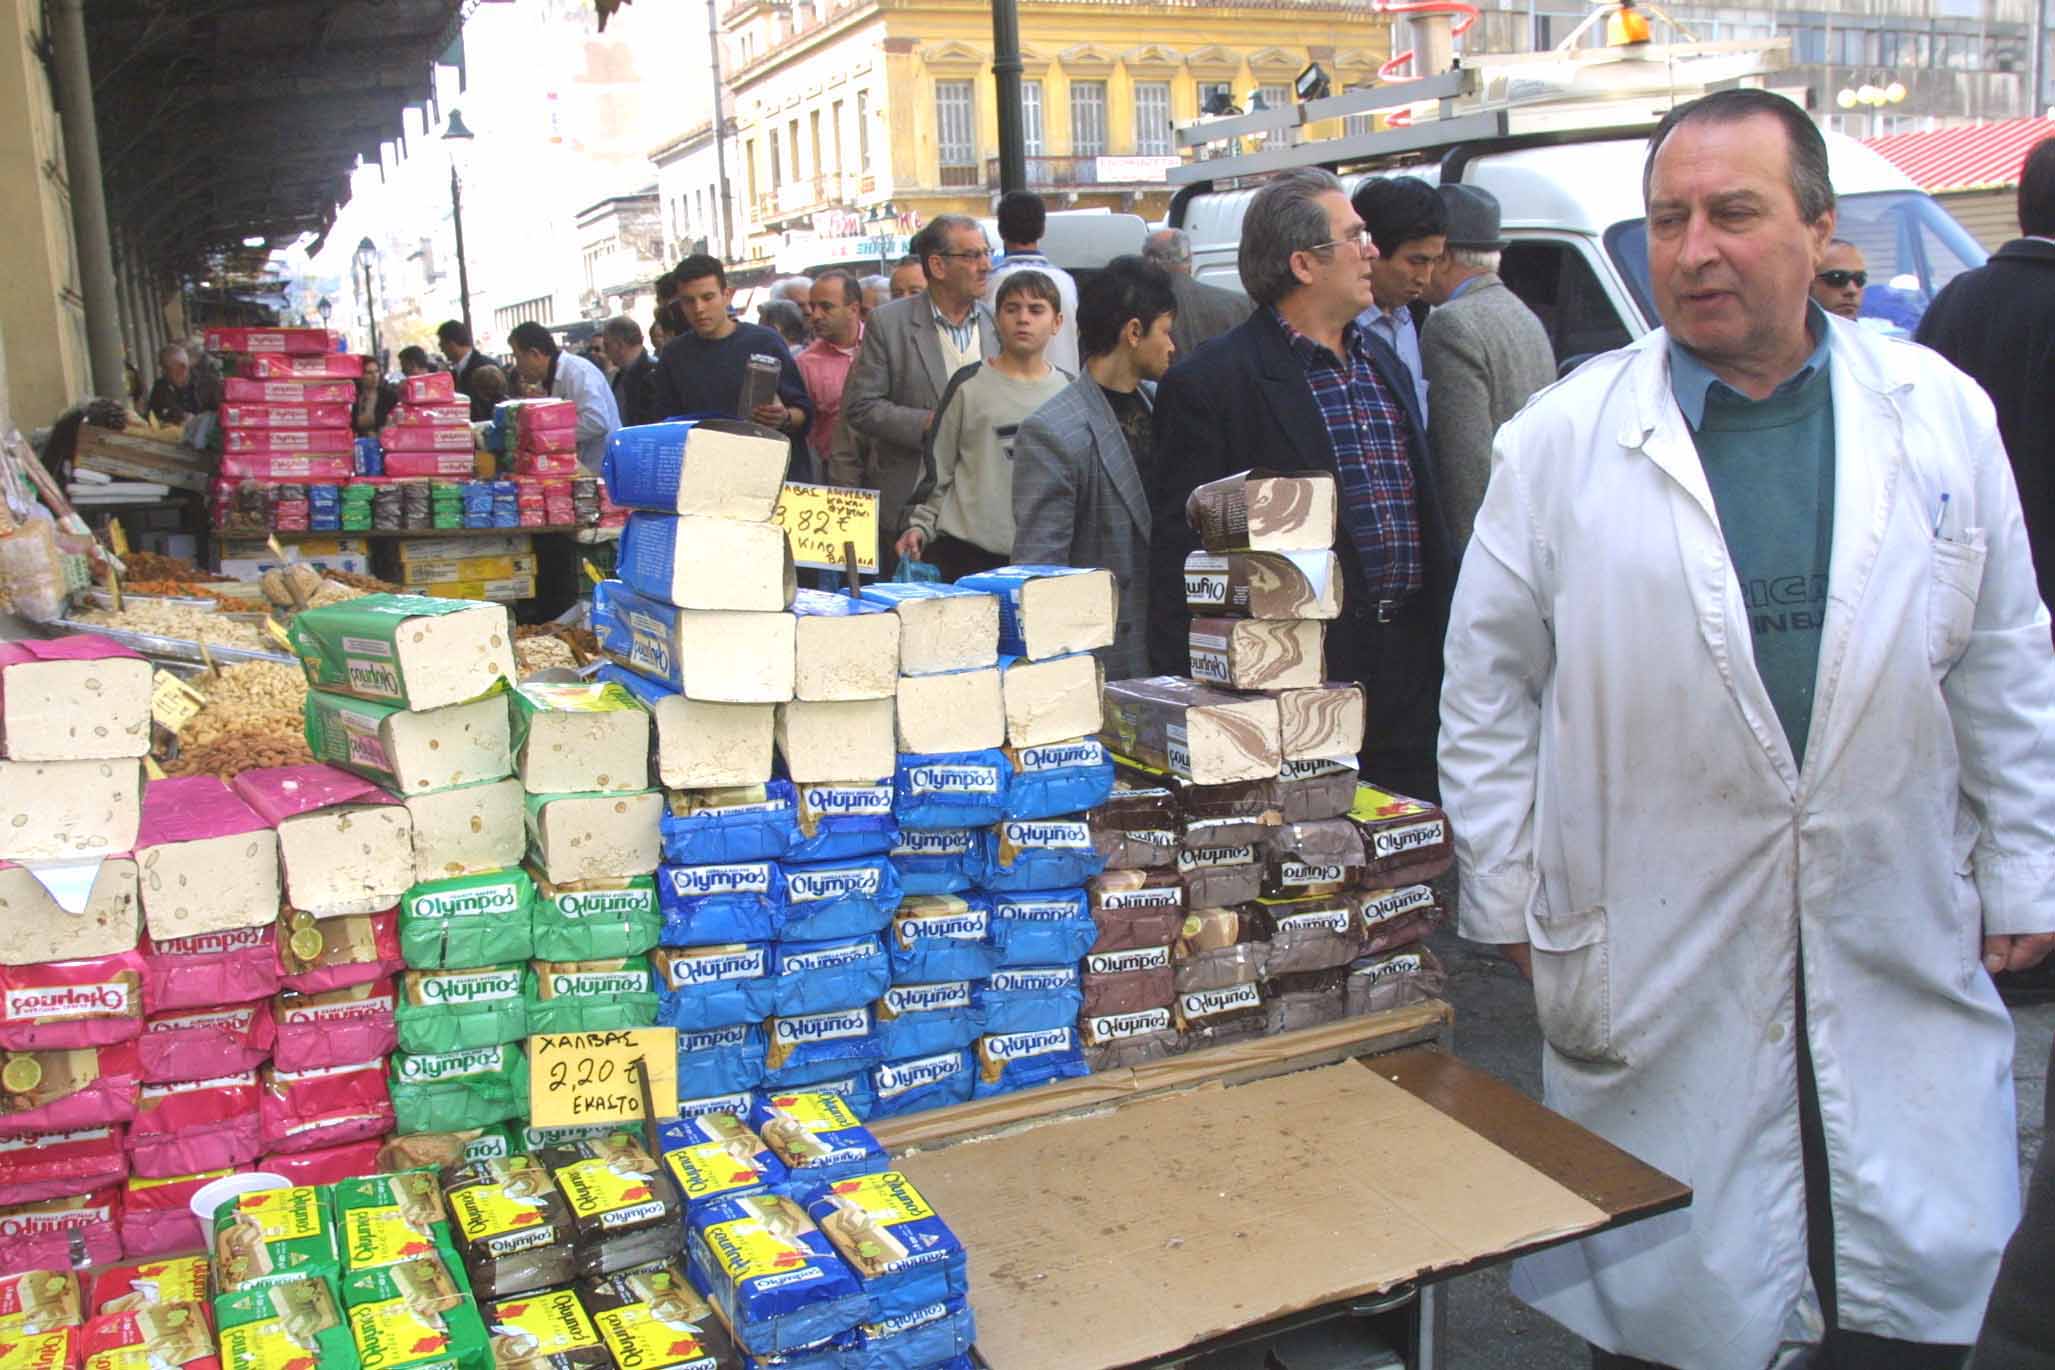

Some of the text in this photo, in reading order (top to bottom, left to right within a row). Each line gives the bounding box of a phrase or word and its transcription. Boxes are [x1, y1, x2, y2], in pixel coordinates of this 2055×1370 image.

[912, 768, 995, 789] Olympos
[1376, 823, 1442, 850] Olympos
[673, 867, 767, 891] Olympos
[791, 869, 879, 896] Olympos
[415, 886, 516, 917] Olympos
[1092, 947, 1166, 973] Olympos
[539, 1031, 639, 1054] ΧΑΛΒΑΣ
[400, 1046, 501, 1078] Olympos
[548, 1057, 615, 1092] 2,20
[878, 1061, 960, 1089] Olympos
[573, 1095, 640, 1114] ΕΚΑΣΤΟ
[602, 1203, 664, 1225] Olympos
[491, 1230, 554, 1251] Olympos
